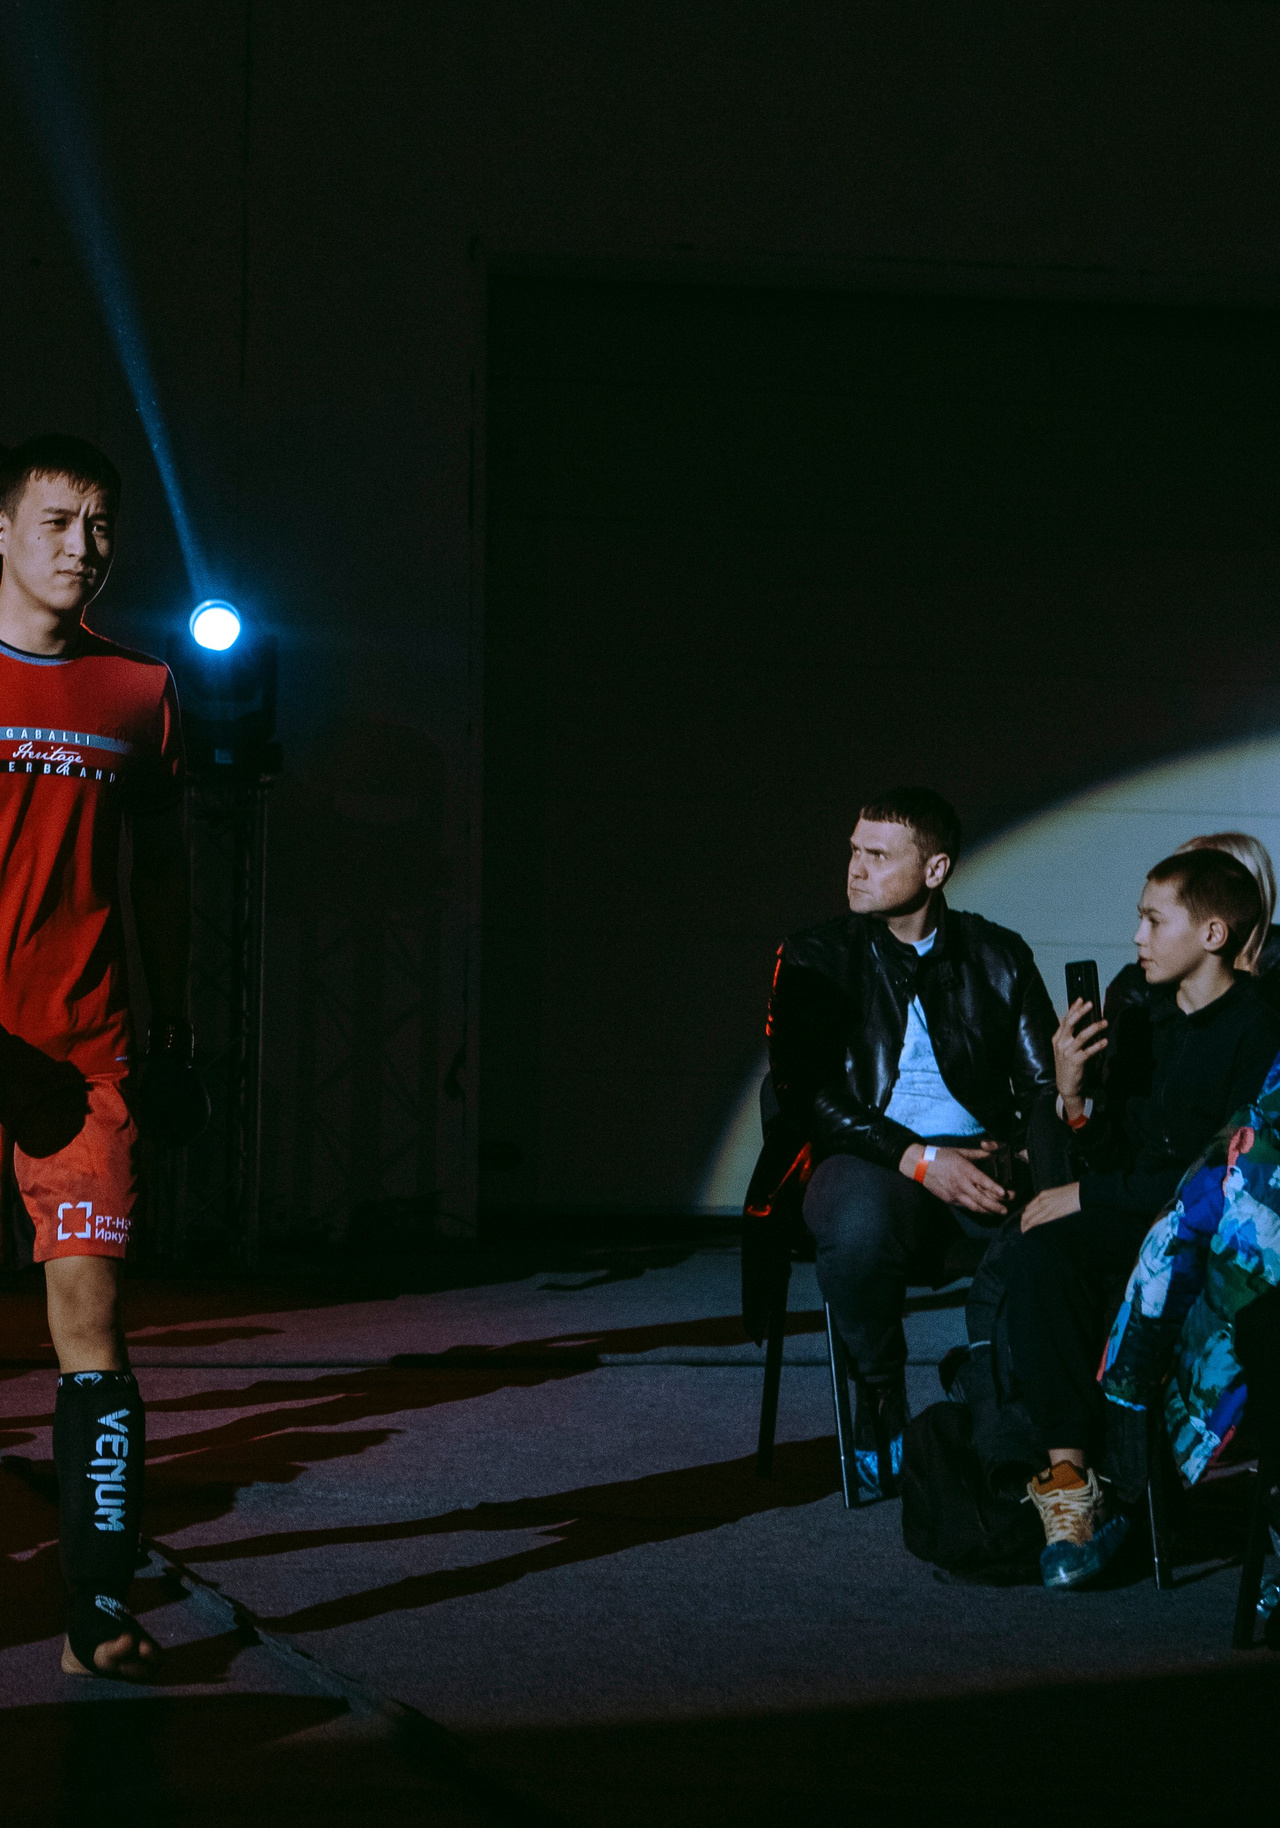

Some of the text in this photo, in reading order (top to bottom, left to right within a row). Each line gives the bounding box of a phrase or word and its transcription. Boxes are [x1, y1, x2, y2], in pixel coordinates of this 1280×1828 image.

[6, 728, 90, 746] GABALLI
[12, 741, 84, 774] Heritage
[95, 1227, 130, 1244] Ирку
[86, 1408, 131, 1532] VENUM
